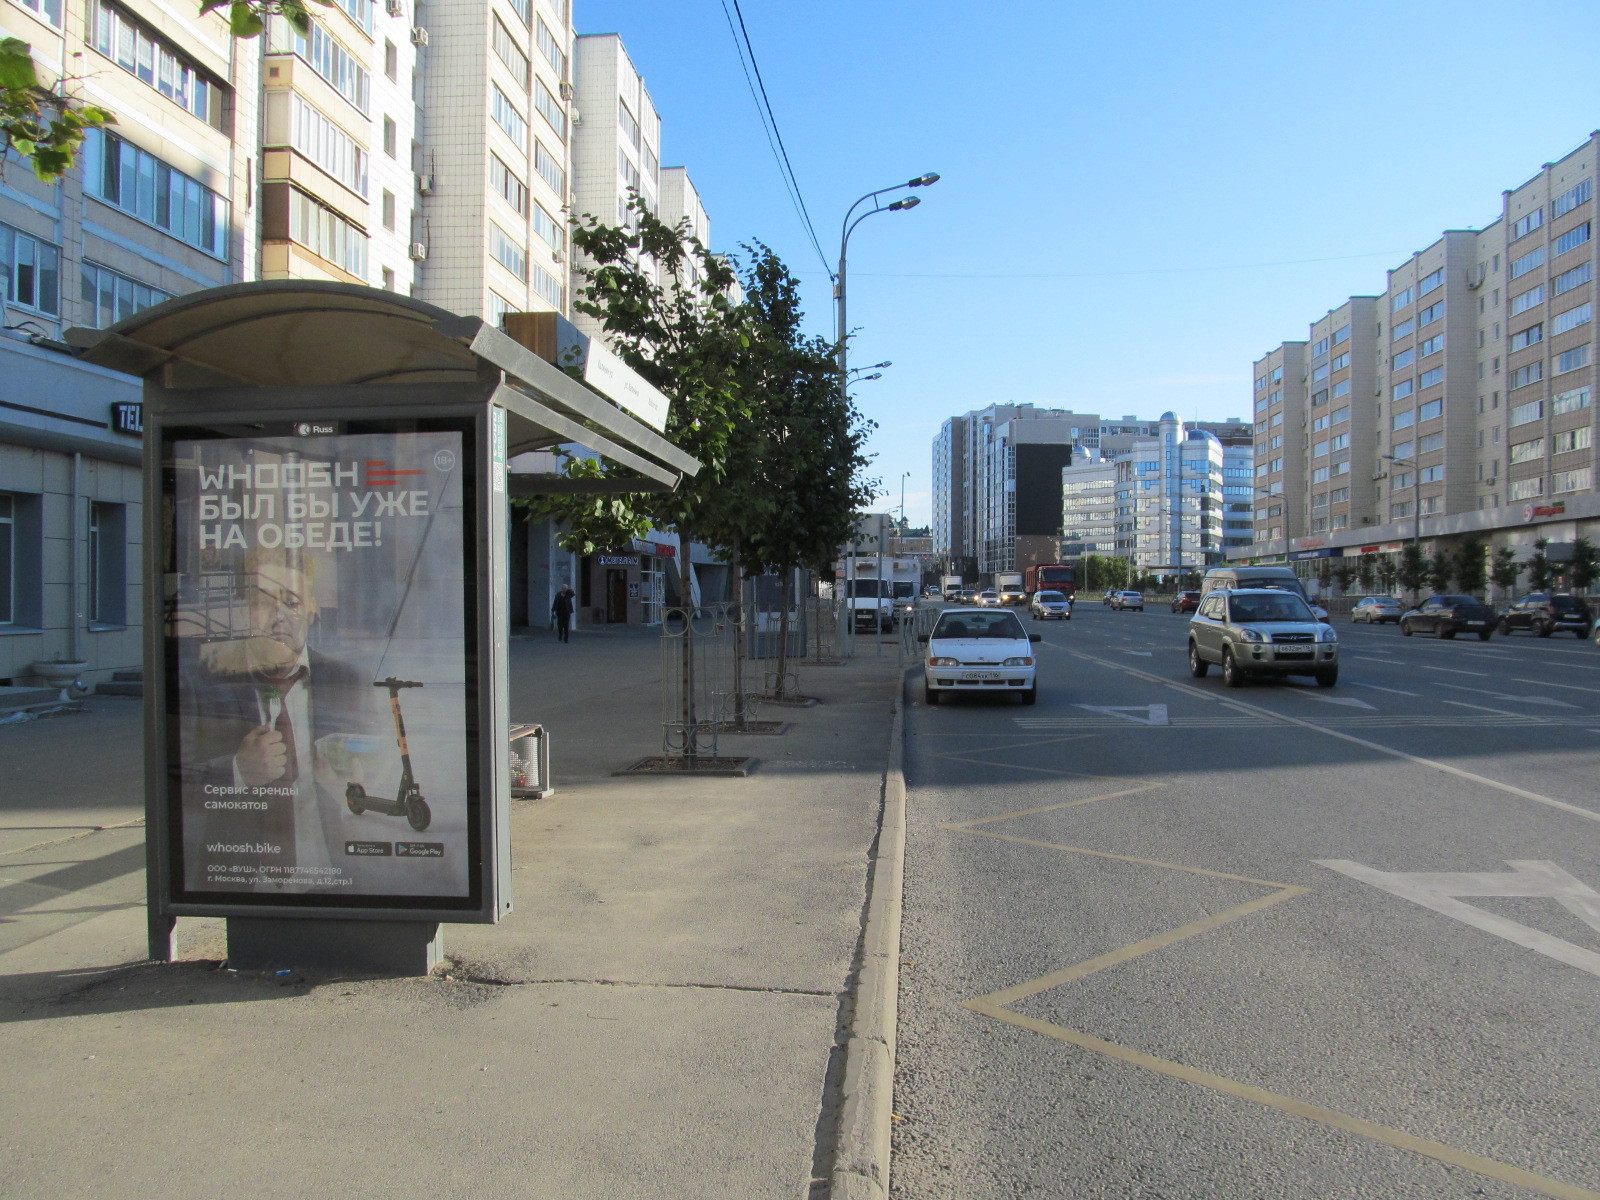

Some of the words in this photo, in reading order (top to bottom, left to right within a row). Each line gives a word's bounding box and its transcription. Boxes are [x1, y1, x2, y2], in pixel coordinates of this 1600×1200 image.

[313, 425, 334, 434] Russ
[436, 456, 453, 466] 18+
[199, 461, 359, 490] WHOOSH
[200, 494, 275, 520] БЫЛ
[288, 492, 339, 519] БЫ
[350, 490, 430, 517] УЖЕ
[200, 523, 248, 550] НА
[257, 521, 382, 551] ОБЕДЕ!
[204, 784, 249, 796] Сервис
[252, 786, 299, 797] аренды
[204, 801, 268, 810] самокатов
[206, 842, 281, 854] whoosh.bike
[409, 848, 429, 856] Google
[430, 848, 441, 856] Play
[207, 864, 227, 872] ООО
[214, 875, 248, 883] Москва,
